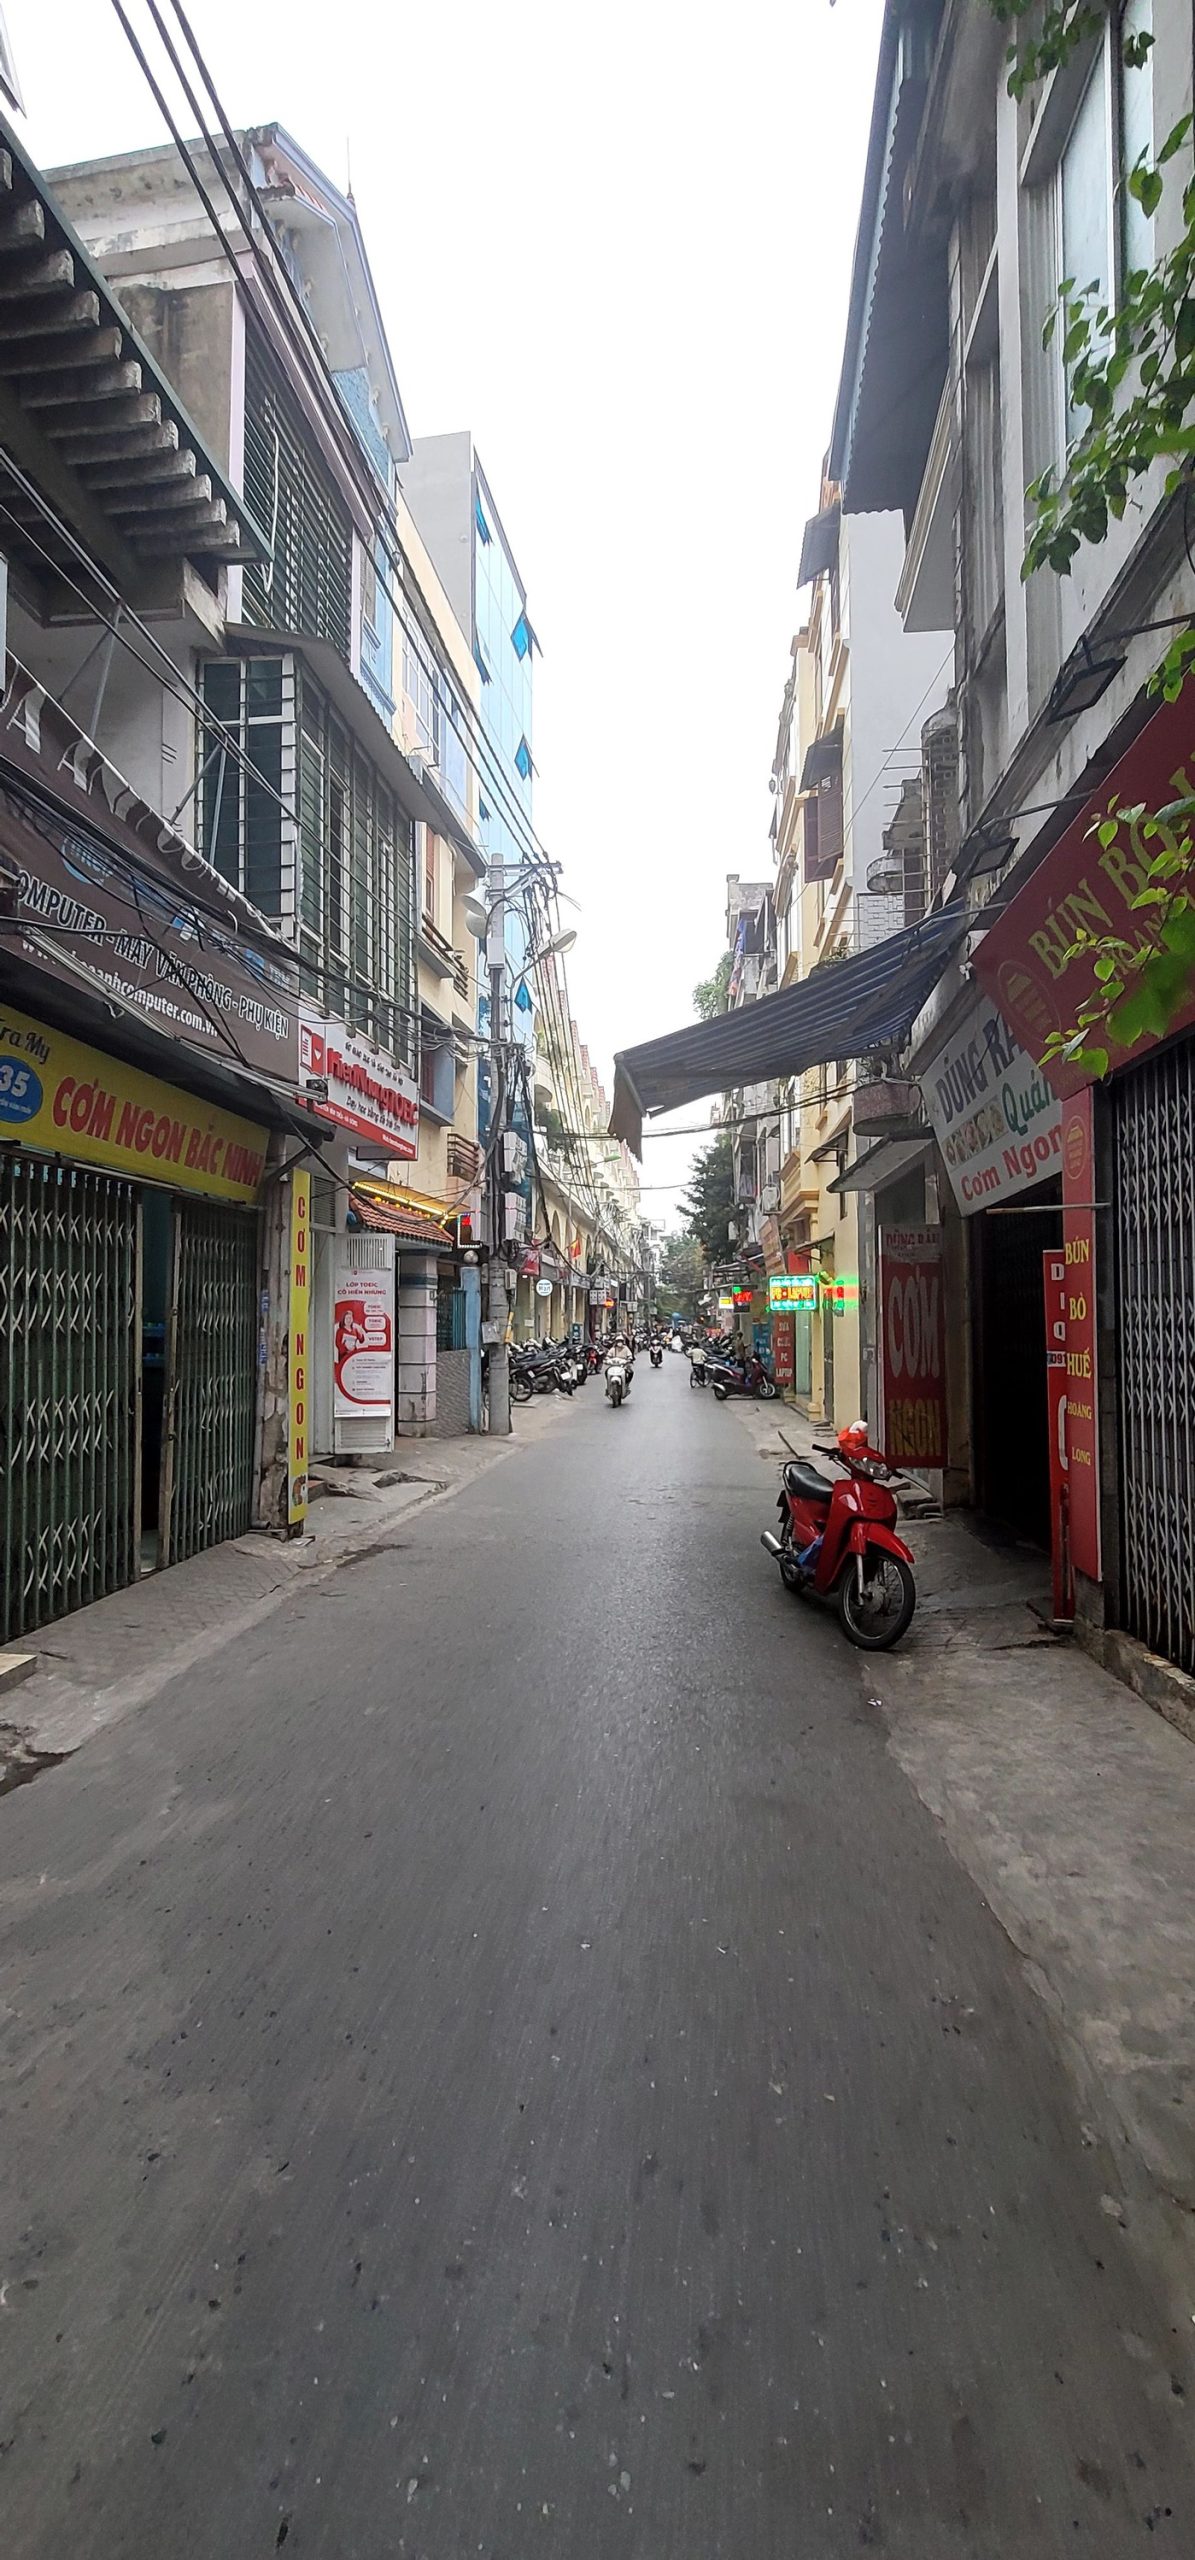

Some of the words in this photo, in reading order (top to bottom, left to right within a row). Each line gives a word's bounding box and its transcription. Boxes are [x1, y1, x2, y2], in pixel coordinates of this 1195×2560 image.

[18, 869, 107, 947] OMPUTER
[238, 995, 264, 1032] PHỤ
[264, 1009, 289, 1041] KIỆN
[53, 1075, 117, 1141] CƠM
[115, 1101, 186, 1163] NGON
[221, 1142, 265, 1188] NINH
[960, 1166, 1001, 1201] Cơm
[1001, 1124, 1063, 1178] Ngon
[1065, 1234, 1090, 1265] BÚN
[887, 1264, 940, 1379] CƠM
[1069, 1292, 1087, 1321] BÒ
[1066, 1346, 1092, 1379] HUẾ
[1067, 1400, 1092, 1420] HOÀNG
[1071, 1446, 1091, 1466] LONG
